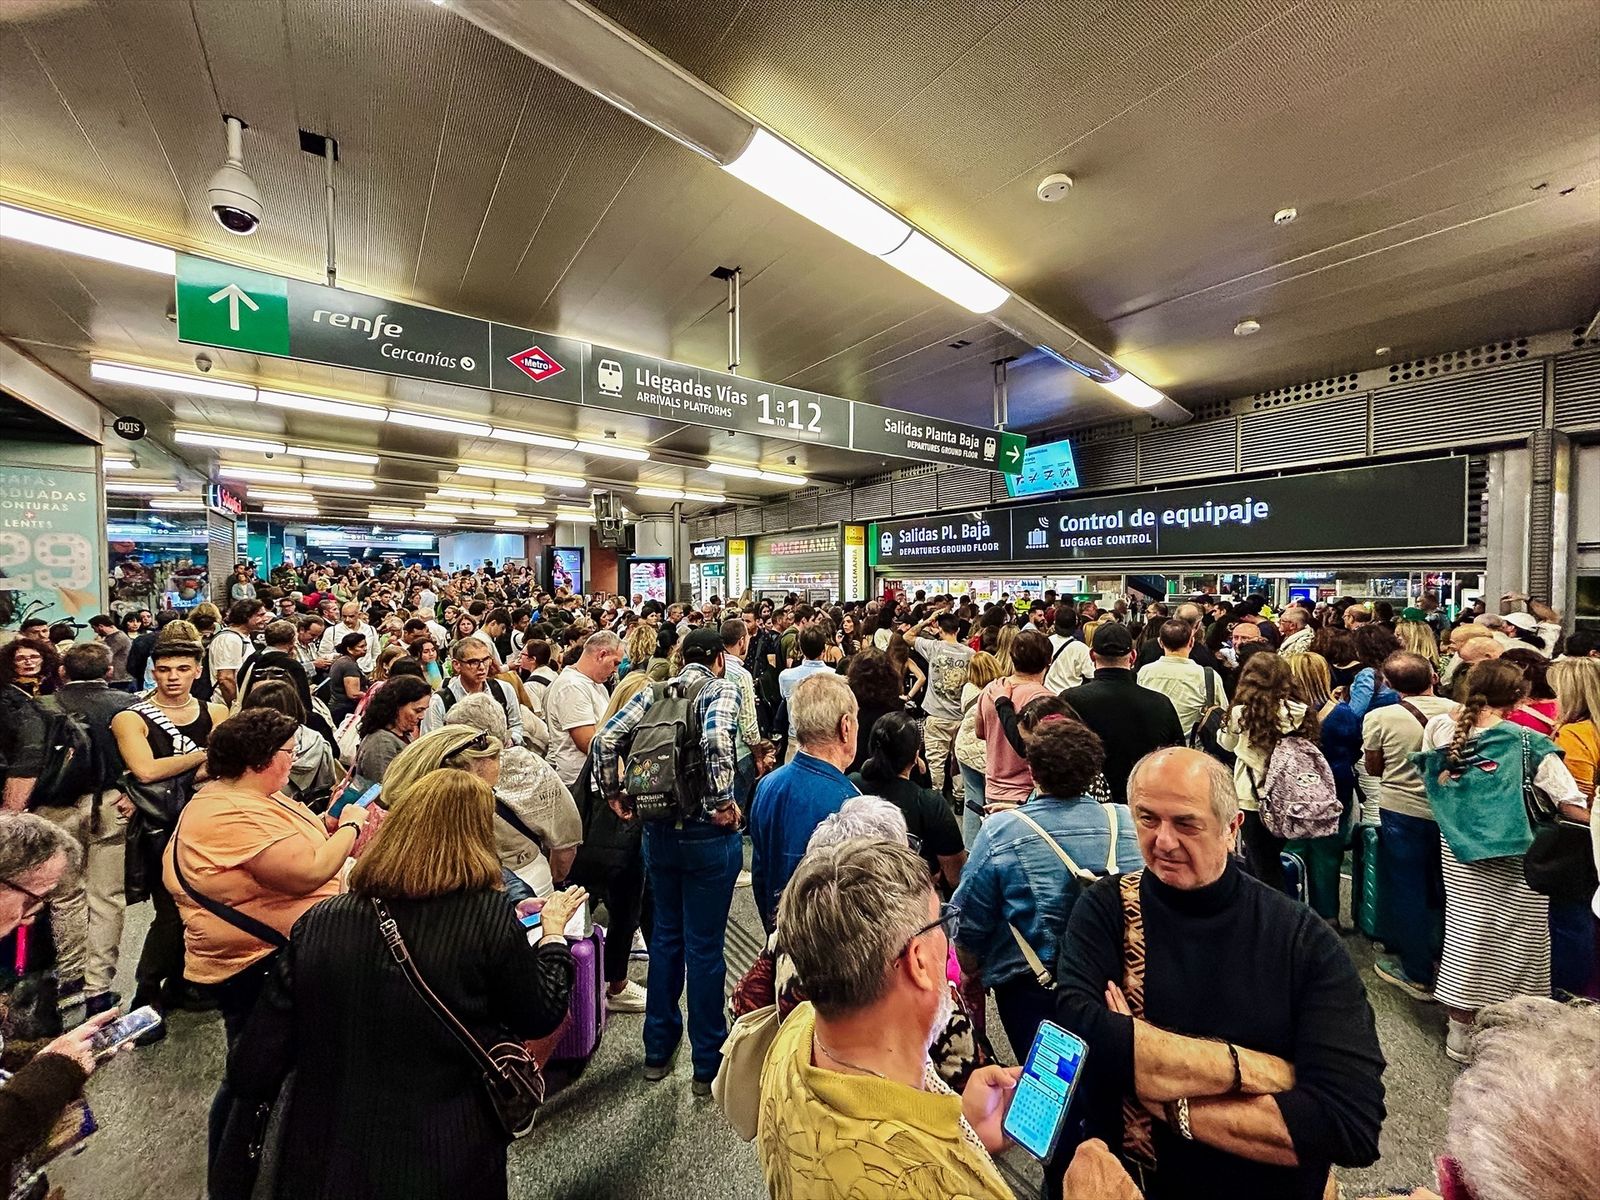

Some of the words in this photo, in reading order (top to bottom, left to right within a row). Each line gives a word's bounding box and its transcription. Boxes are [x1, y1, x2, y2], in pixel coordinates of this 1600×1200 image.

[312, 309, 403, 340] renfe
[380, 343, 457, 369] Cercanías
[524, 357, 549, 370] Metro
[635, 367, 712, 399] Llegadas
[716, 384, 748, 406] Vías
[636, 391, 681, 409] ARRIVALS
[683, 399, 732, 418] PLATFORMS
[757, 393, 775, 425] 1
[776, 400, 785, 413] a
[787, 399, 822, 433] 12
[118, 421, 140, 432] DOTS
[775, 416, 786, 427] TO
[884, 418, 923, 438] Salidas
[925, 426, 957, 444] Planta
[959, 432, 980, 450] Baja
[906, 440, 941, 453] DEPARTURES
[941, 446, 962, 457] GROUND
[962, 449, 979, 459] FLOOR
[4, 519, 54, 529] LENTES
[1059, 510, 1124, 533] Control
[1130, 508, 1156, 527] de
[1162, 497, 1270, 529] equipaje
[899, 527, 939, 543] Salidas
[941, 524, 958, 540] Pl.
[961, 521, 991, 541] Baja
[1060, 536, 1103, 548] LUGGAGE
[1106, 533, 1152, 545] CONTROL
[899, 545, 940, 556] DEPARTURES
[941, 543, 973, 554] GROUND
[973, 542, 999, 552] FLOOR
